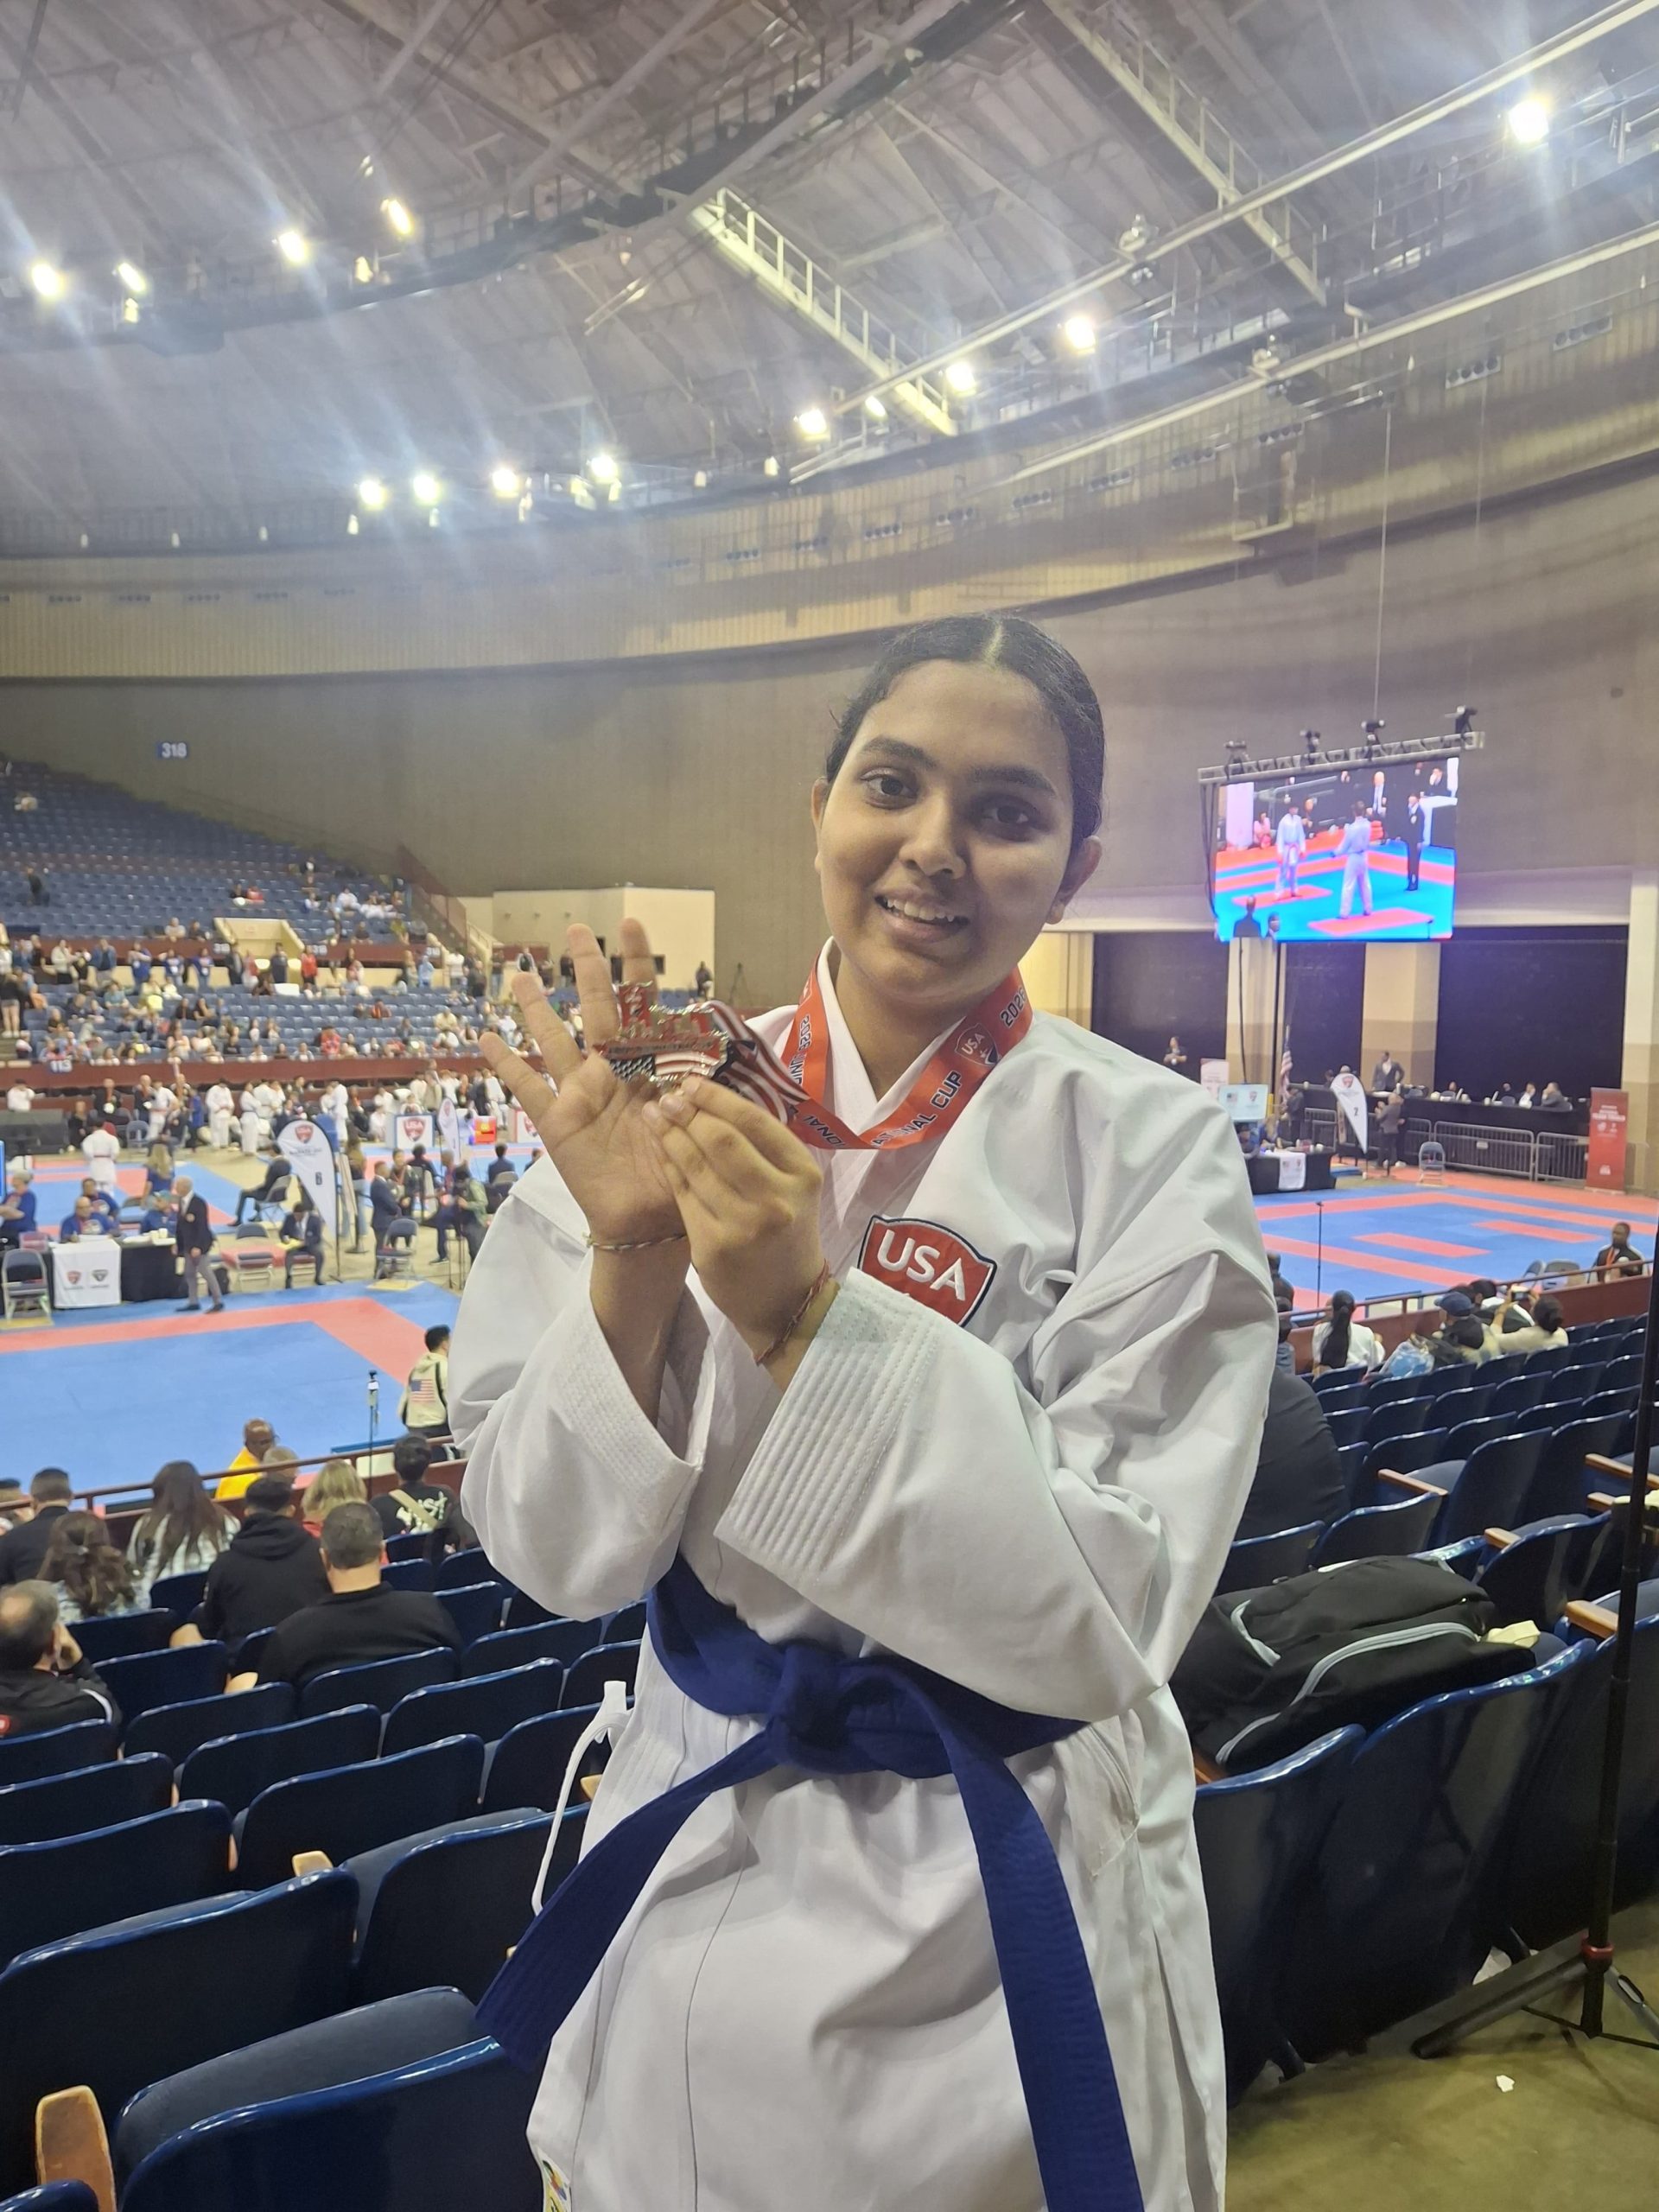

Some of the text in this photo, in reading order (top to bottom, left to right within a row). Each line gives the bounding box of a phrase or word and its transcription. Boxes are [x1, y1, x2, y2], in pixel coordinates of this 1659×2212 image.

[962, 1033, 985, 1055] USA
[930, 1070, 963, 1109] CUP
[877, 1229, 966, 1301] USA
